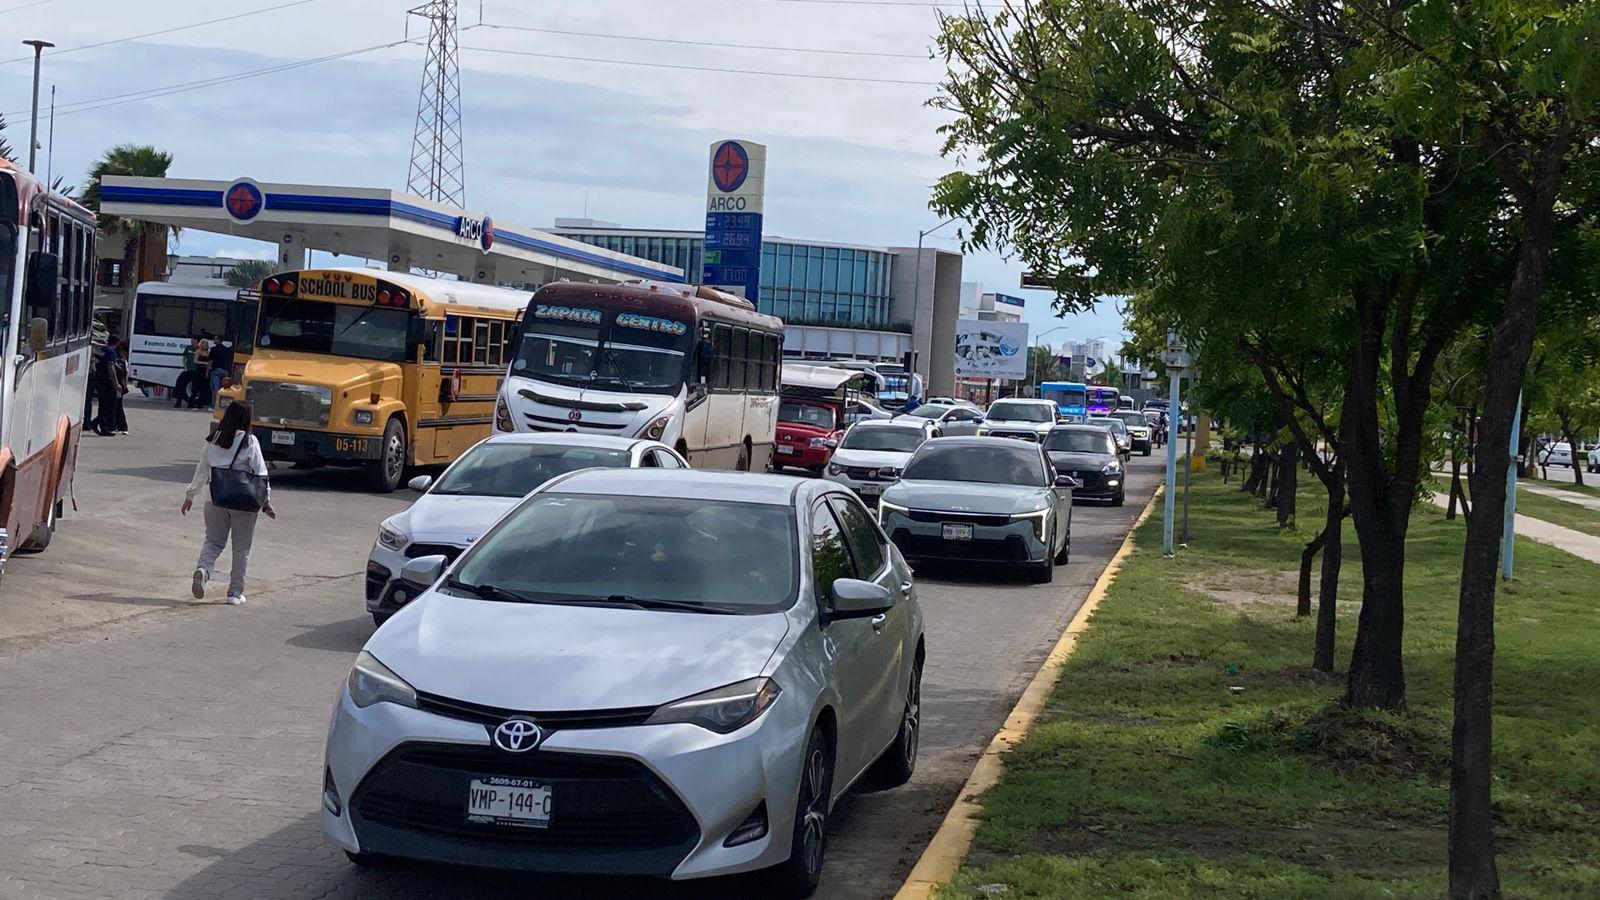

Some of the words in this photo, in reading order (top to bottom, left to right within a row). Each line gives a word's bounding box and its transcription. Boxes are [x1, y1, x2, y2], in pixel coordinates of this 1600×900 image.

[709, 197, 746, 211] ARCO
[459, 217, 481, 240] ARCO
[300, 278, 346, 298] SCHOOL
[352, 283, 375, 300] BUS
[534, 304, 602, 325] ZAPATA
[615, 312, 687, 336] CENTRO
[568, 410, 582, 421] 09
[336, 438, 368, 453] 05-113
[490, 777, 533, 788] 3609-67-01
